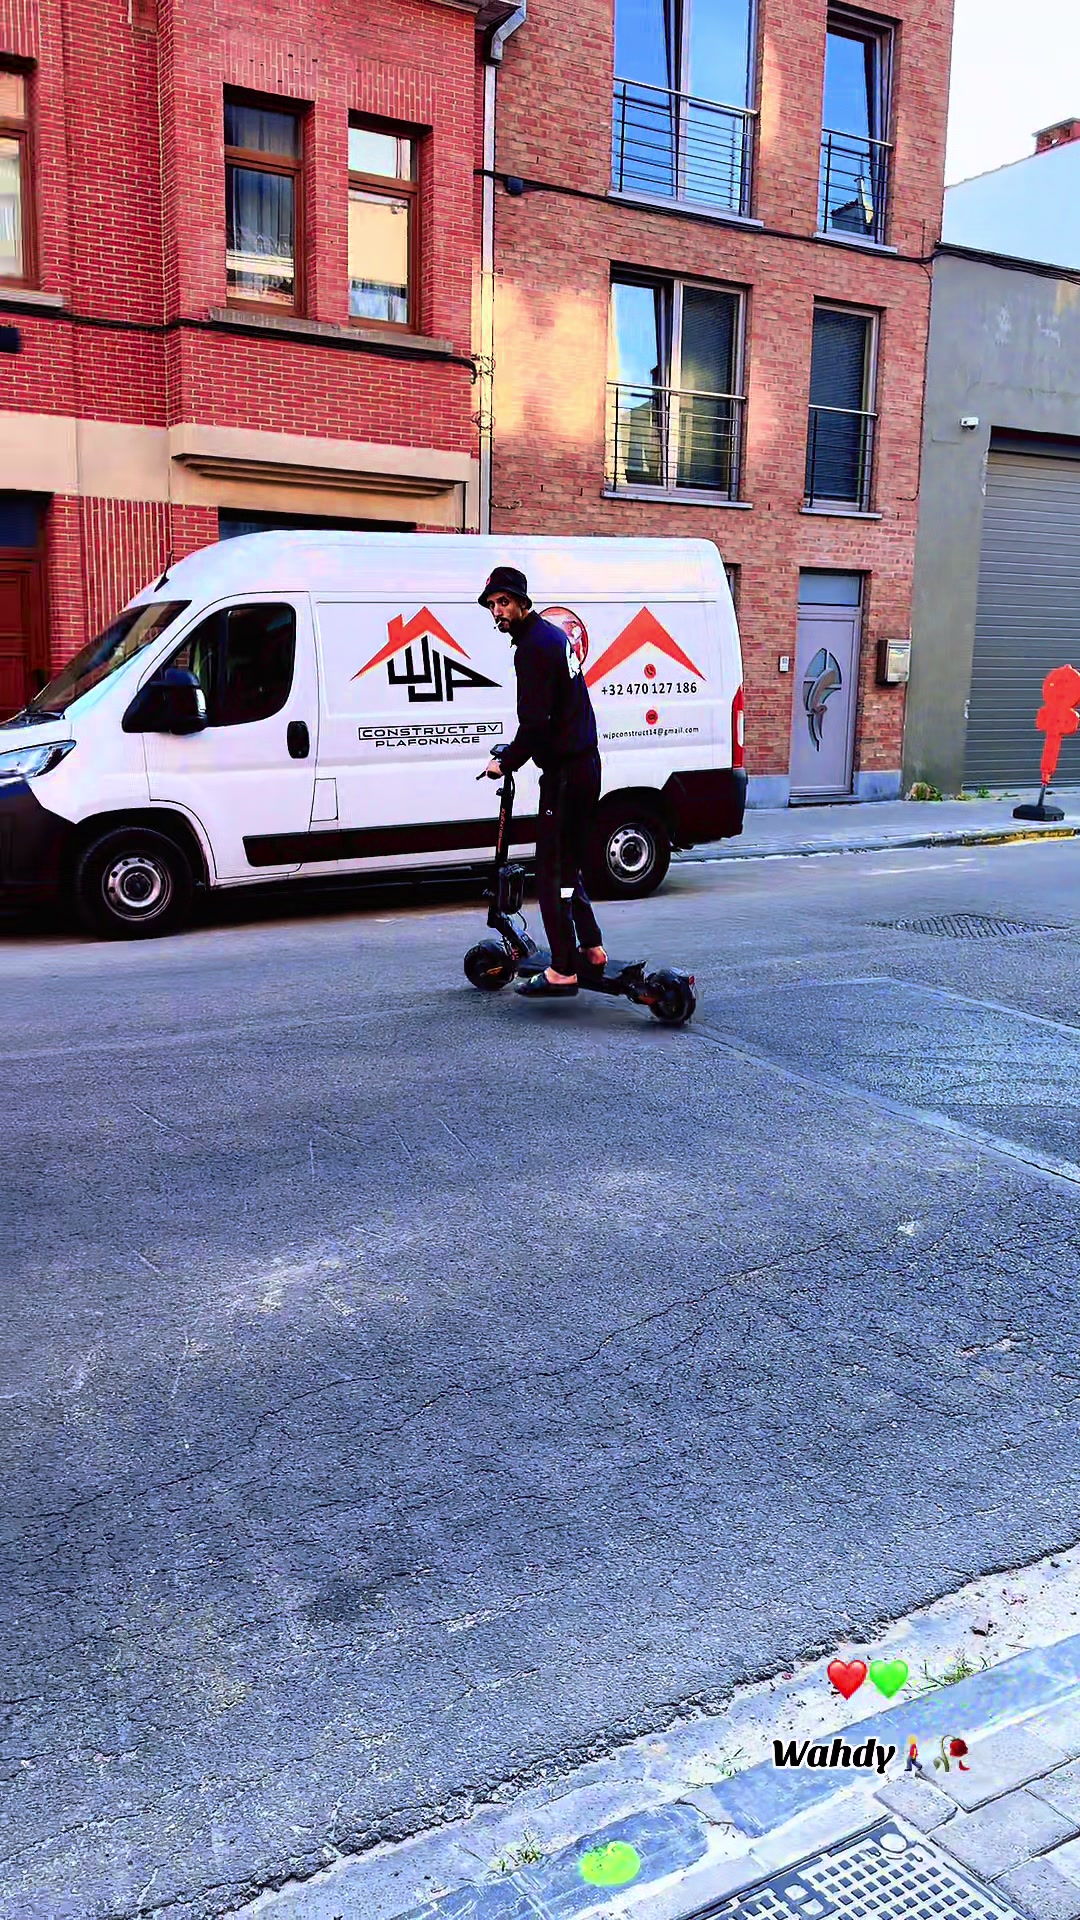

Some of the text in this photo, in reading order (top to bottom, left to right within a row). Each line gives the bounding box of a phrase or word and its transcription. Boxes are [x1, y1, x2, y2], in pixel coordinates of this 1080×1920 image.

[601, 681, 698, 696] +32 470 127 186
[362, 724, 499, 738] CONSTRUCT BV
[375, 736, 480, 748] PLAFONNAGE
